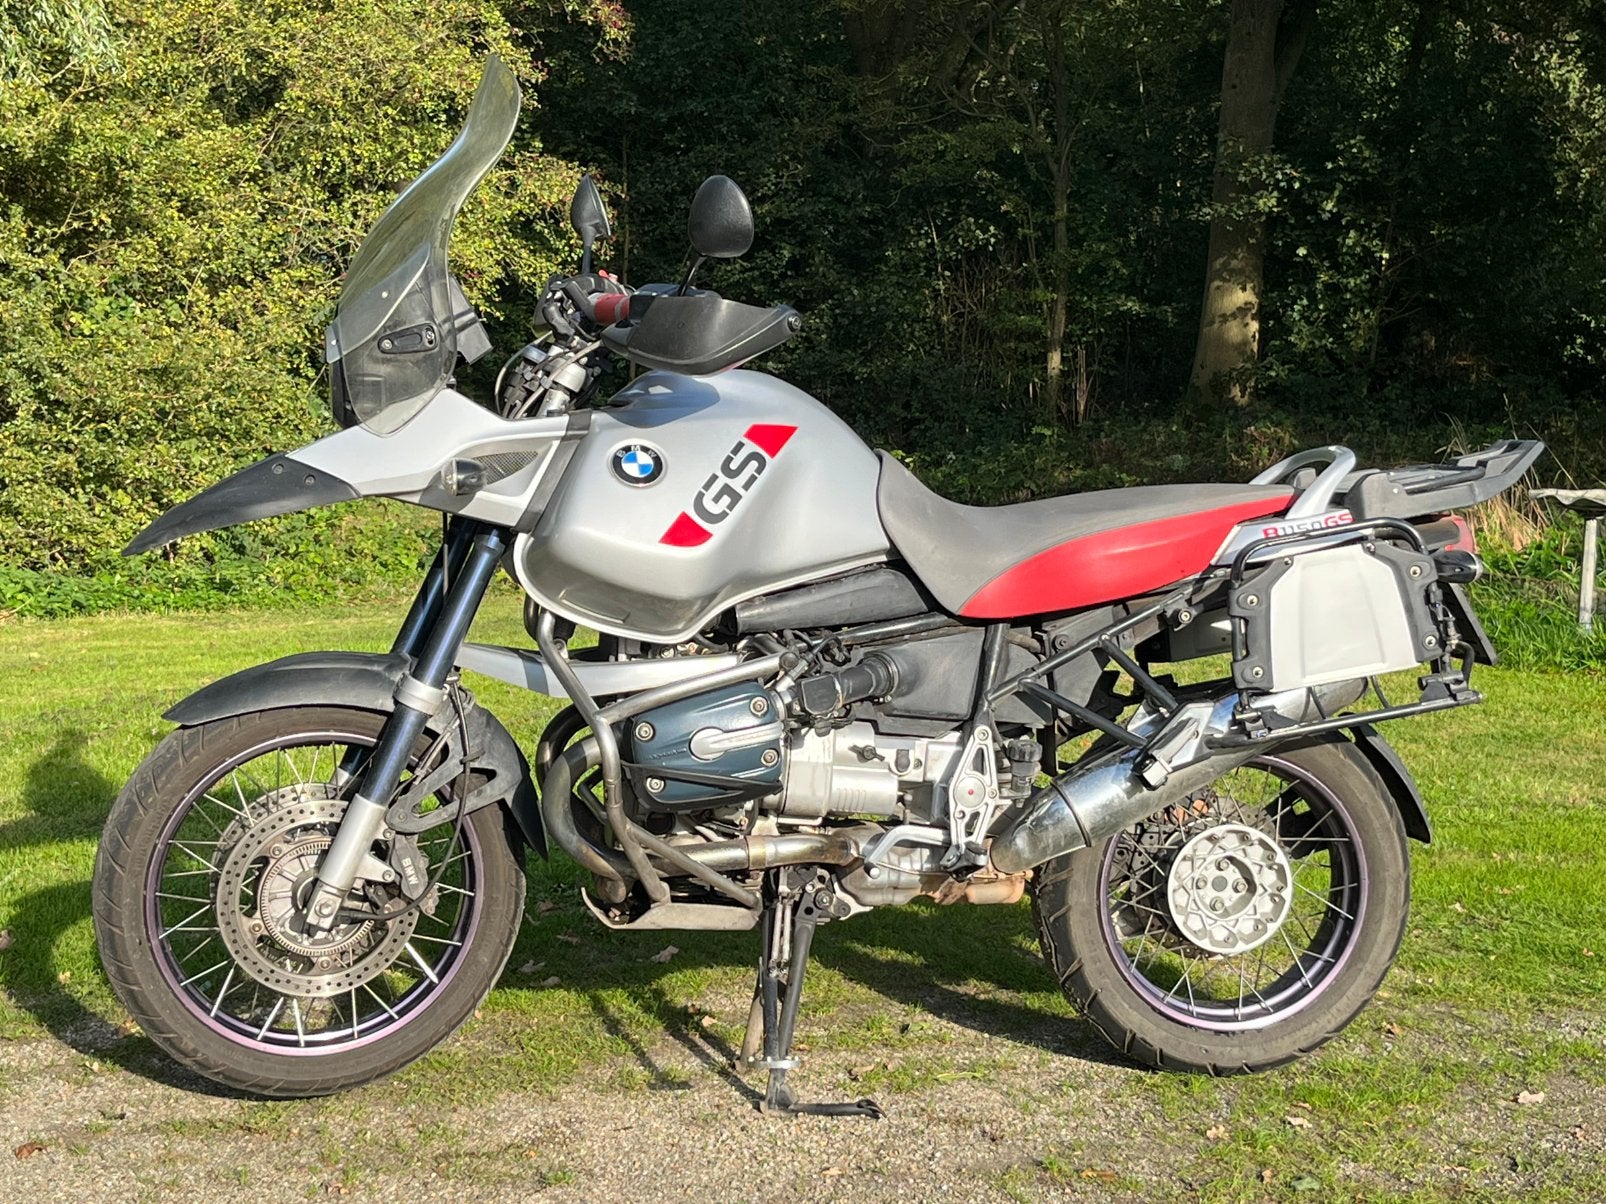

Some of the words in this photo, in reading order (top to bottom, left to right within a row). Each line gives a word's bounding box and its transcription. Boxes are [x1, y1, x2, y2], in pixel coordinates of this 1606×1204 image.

[616, 445, 658, 458] BMW
[693, 440, 767, 524] GS
[401, 857, 419, 885] BMW
